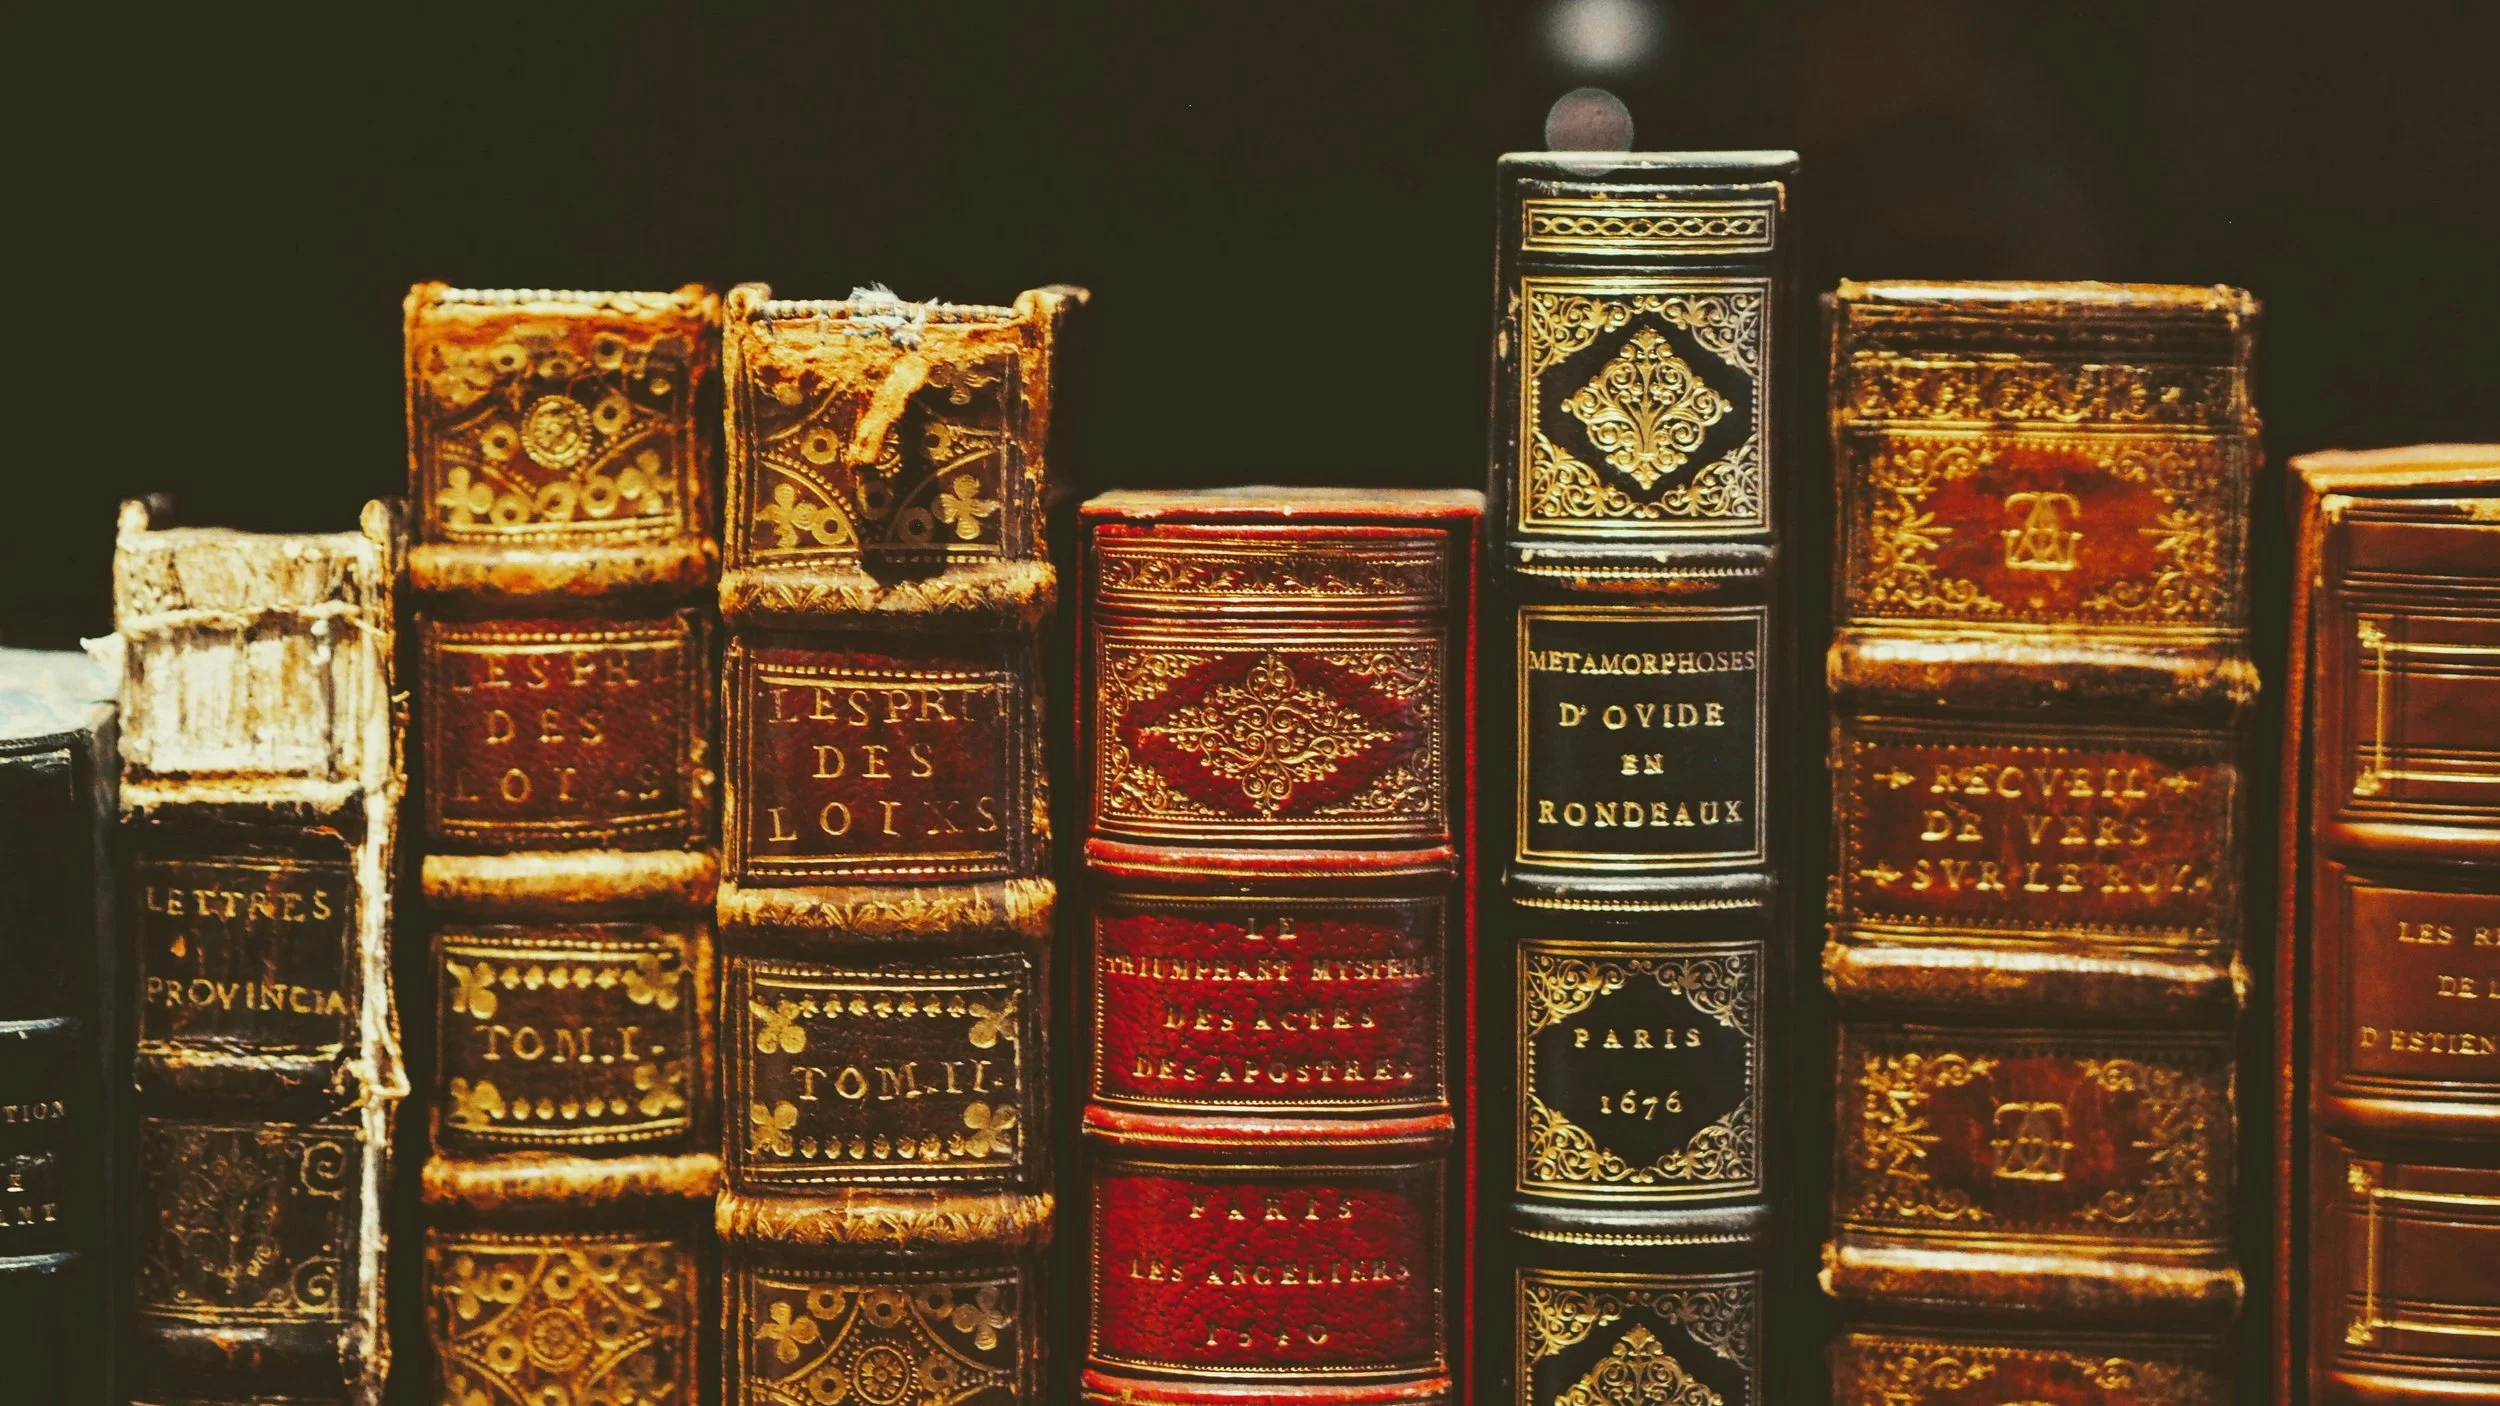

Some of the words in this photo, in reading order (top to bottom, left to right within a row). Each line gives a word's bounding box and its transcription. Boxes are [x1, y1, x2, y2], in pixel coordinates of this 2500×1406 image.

[1529, 651, 1756, 676] METAMORPHOSES
[486, 708, 604, 745] DES
[812, 744, 934, 779] DES
[1621, 753, 1664, 776] EN
[767, 796, 999, 843] LOIXS
[1538, 800, 1744, 828] RONDEAUX
[1920, 809, 1984, 842] DE
[2023, 815, 2149, 847] VERS
[146, 887, 332, 922] LETTRES
[2398, 921, 2454, 945] LES
[2437, 975, 2479, 999] DE
[1162, 1006, 1235, 1032] DES
[1254, 1007, 1376, 1031] ACTES
[1573, 1028, 1701, 1049] PARIS
[1601, 1089, 1683, 1121] 1676
[1130, 1258, 1185, 1282] LES
